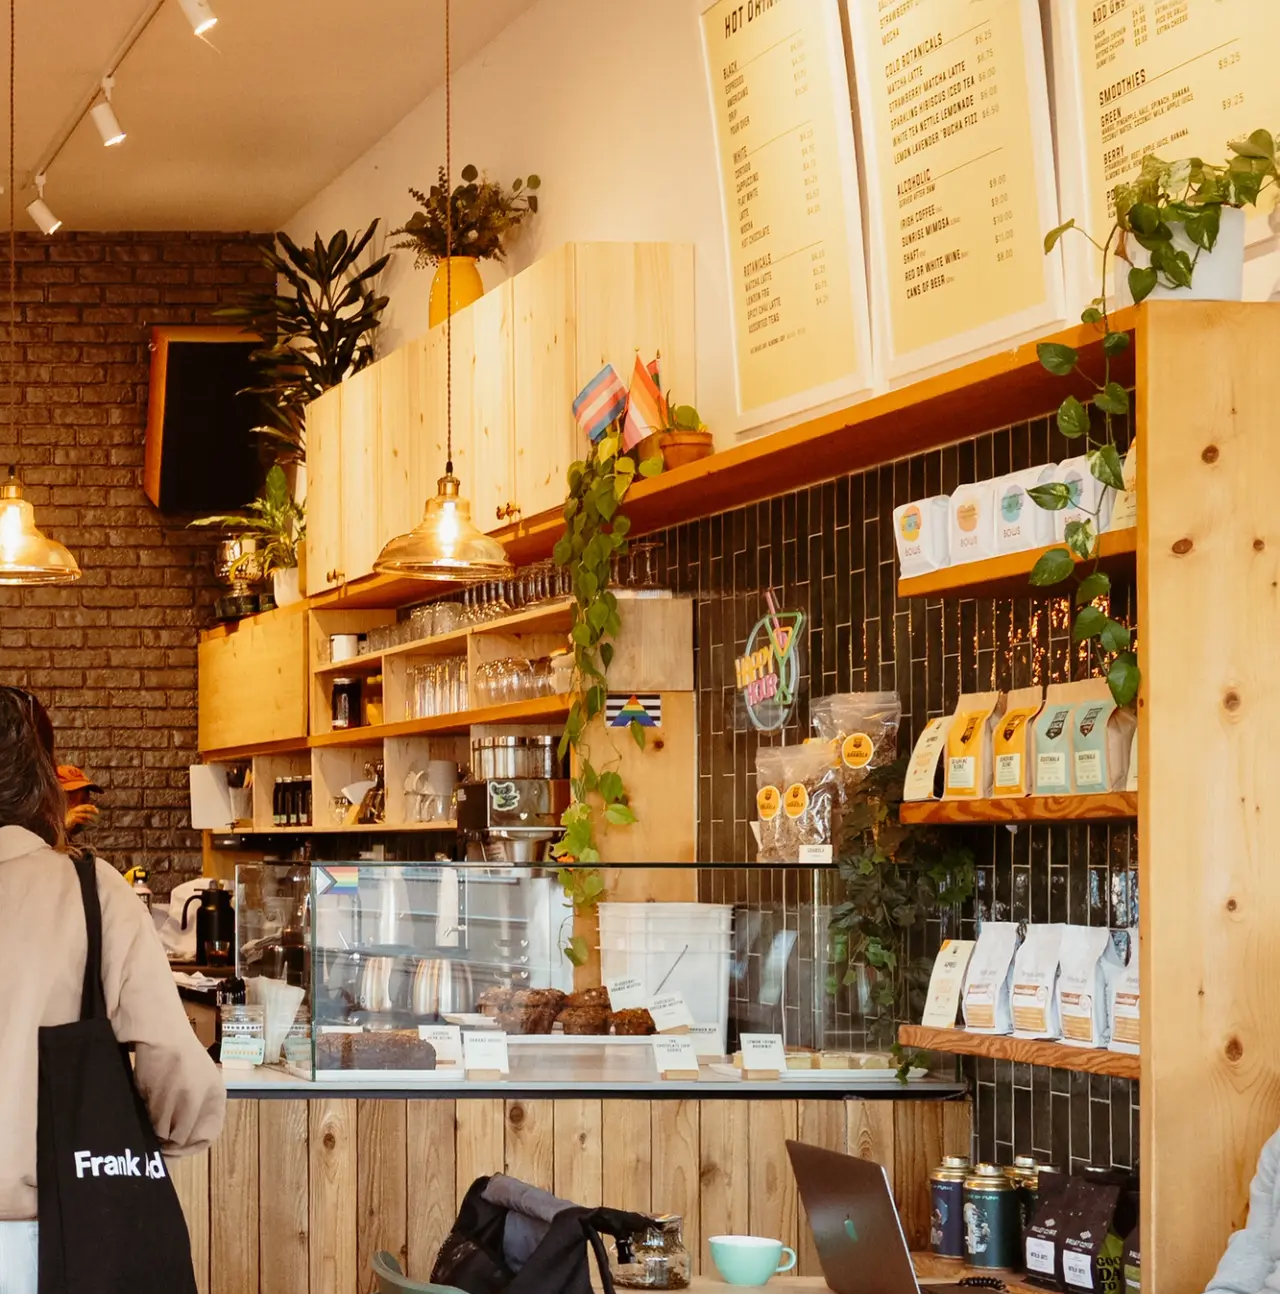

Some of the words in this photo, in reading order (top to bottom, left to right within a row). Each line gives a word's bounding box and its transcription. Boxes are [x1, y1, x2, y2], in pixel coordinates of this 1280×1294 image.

[725, 5, 743, 39] HOT
[880, 0, 915, 29] STRAWBERRY
[1092, 4, 1107, 26] ADD
[1156, 22, 1170, 35] EXTRA
[1171, 13, 1188, 29] CHEESE
[882, 28, 899, 46] MOCHA
[885, 58, 900, 78] COLD
[901, 32, 943, 67] BOTANICALS
[723, 61, 738, 80] BLACK
[887, 75, 906, 95] MATCHA
[908, 65, 923, 82] LATTE
[725, 75, 744, 95] ESPRESSO
[727, 87, 748, 108] AMERICANO
[889, 84, 921, 113] STRAWBERRY
[923, 71, 946, 92] MATCHA
[948, 60, 966, 79] LATTE
[1099, 68, 1146, 106] SMOOTHIES
[1101, 106, 1121, 128] GREEN
[1218, 51, 1241, 70] $9.25
[1172, 86, 1190, 100] BANANA
[890, 105, 918, 131] SPARKLING
[919, 90, 946, 114] HIBISCUS
[947, 81, 961, 98] ICED
[963, 75, 975, 90] TEA
[892, 130, 908, 147] WHITE
[909, 123, 918, 137] TEA
[920, 112, 940, 132] NETTLE
[941, 94, 974, 121] LEMONADE
[1102, 130, 1118, 144] COCONUT
[1134, 112, 1152, 128] COCONUT
[1167, 98, 1180, 112] APPLE
[1104, 145, 1125, 165] BERRY
[1222, 93, 1244, 110] $9.25
[894, 147, 911, 165] LEMON
[912, 131, 940, 155] LAVENDER
[964, 112, 978, 128] FIZZ
[1143, 143, 1155, 156] APPLE
[1171, 128, 1189, 142] BANANA
[733, 145, 747, 165] WHITE
[735, 162, 750, 179] CORTADO
[737, 172, 758, 193] CAPPUCCINO
[897, 168, 931, 196] ALCOHOLIC
[1105, 167, 1120, 181] ALMOND
[747, 187, 758, 201] WHITE
[899, 194, 913, 209] SERVED
[914, 188, 926, 201] AFTER
[740, 208, 749, 221] LATTE
[901, 214, 914, 231] IRISH
[915, 204, 936, 223] COFFEE
[741, 220, 753, 235] MOCHA
[749, 225, 770, 244] CHOCOLATE
[902, 228, 924, 247] SUNRISE
[925, 217, 950, 236] MIMOSA
[743, 252, 772, 277] BOTANICALS
[903, 248, 919, 265] SHAFT
[904, 269, 915, 282] RED
[916, 265, 924, 278] OR
[925, 256, 943, 273] WHITE
[945, 249, 961, 265] WINE
[745, 277, 760, 292] MATCHA
[761, 271, 772, 285] LATTE
[906, 285, 921, 300] CANS
[922, 281, 929, 293] OF
[930, 274, 945, 290] BEER
[746, 292, 760, 306] LONDON
[761, 287, 769, 298] FOG
[747, 308, 758, 320] SPICY
[758, 303, 768, 315] CHAI
[769, 296, 781, 310] LATTE
[748, 317, 768, 334] ASSORTED
[768, 312, 780, 325] TEAS
[735, 644, 773, 688] HAPPY
[748, 673, 777, 706] HOUR
[73, 1148, 141, 1178] Frank
